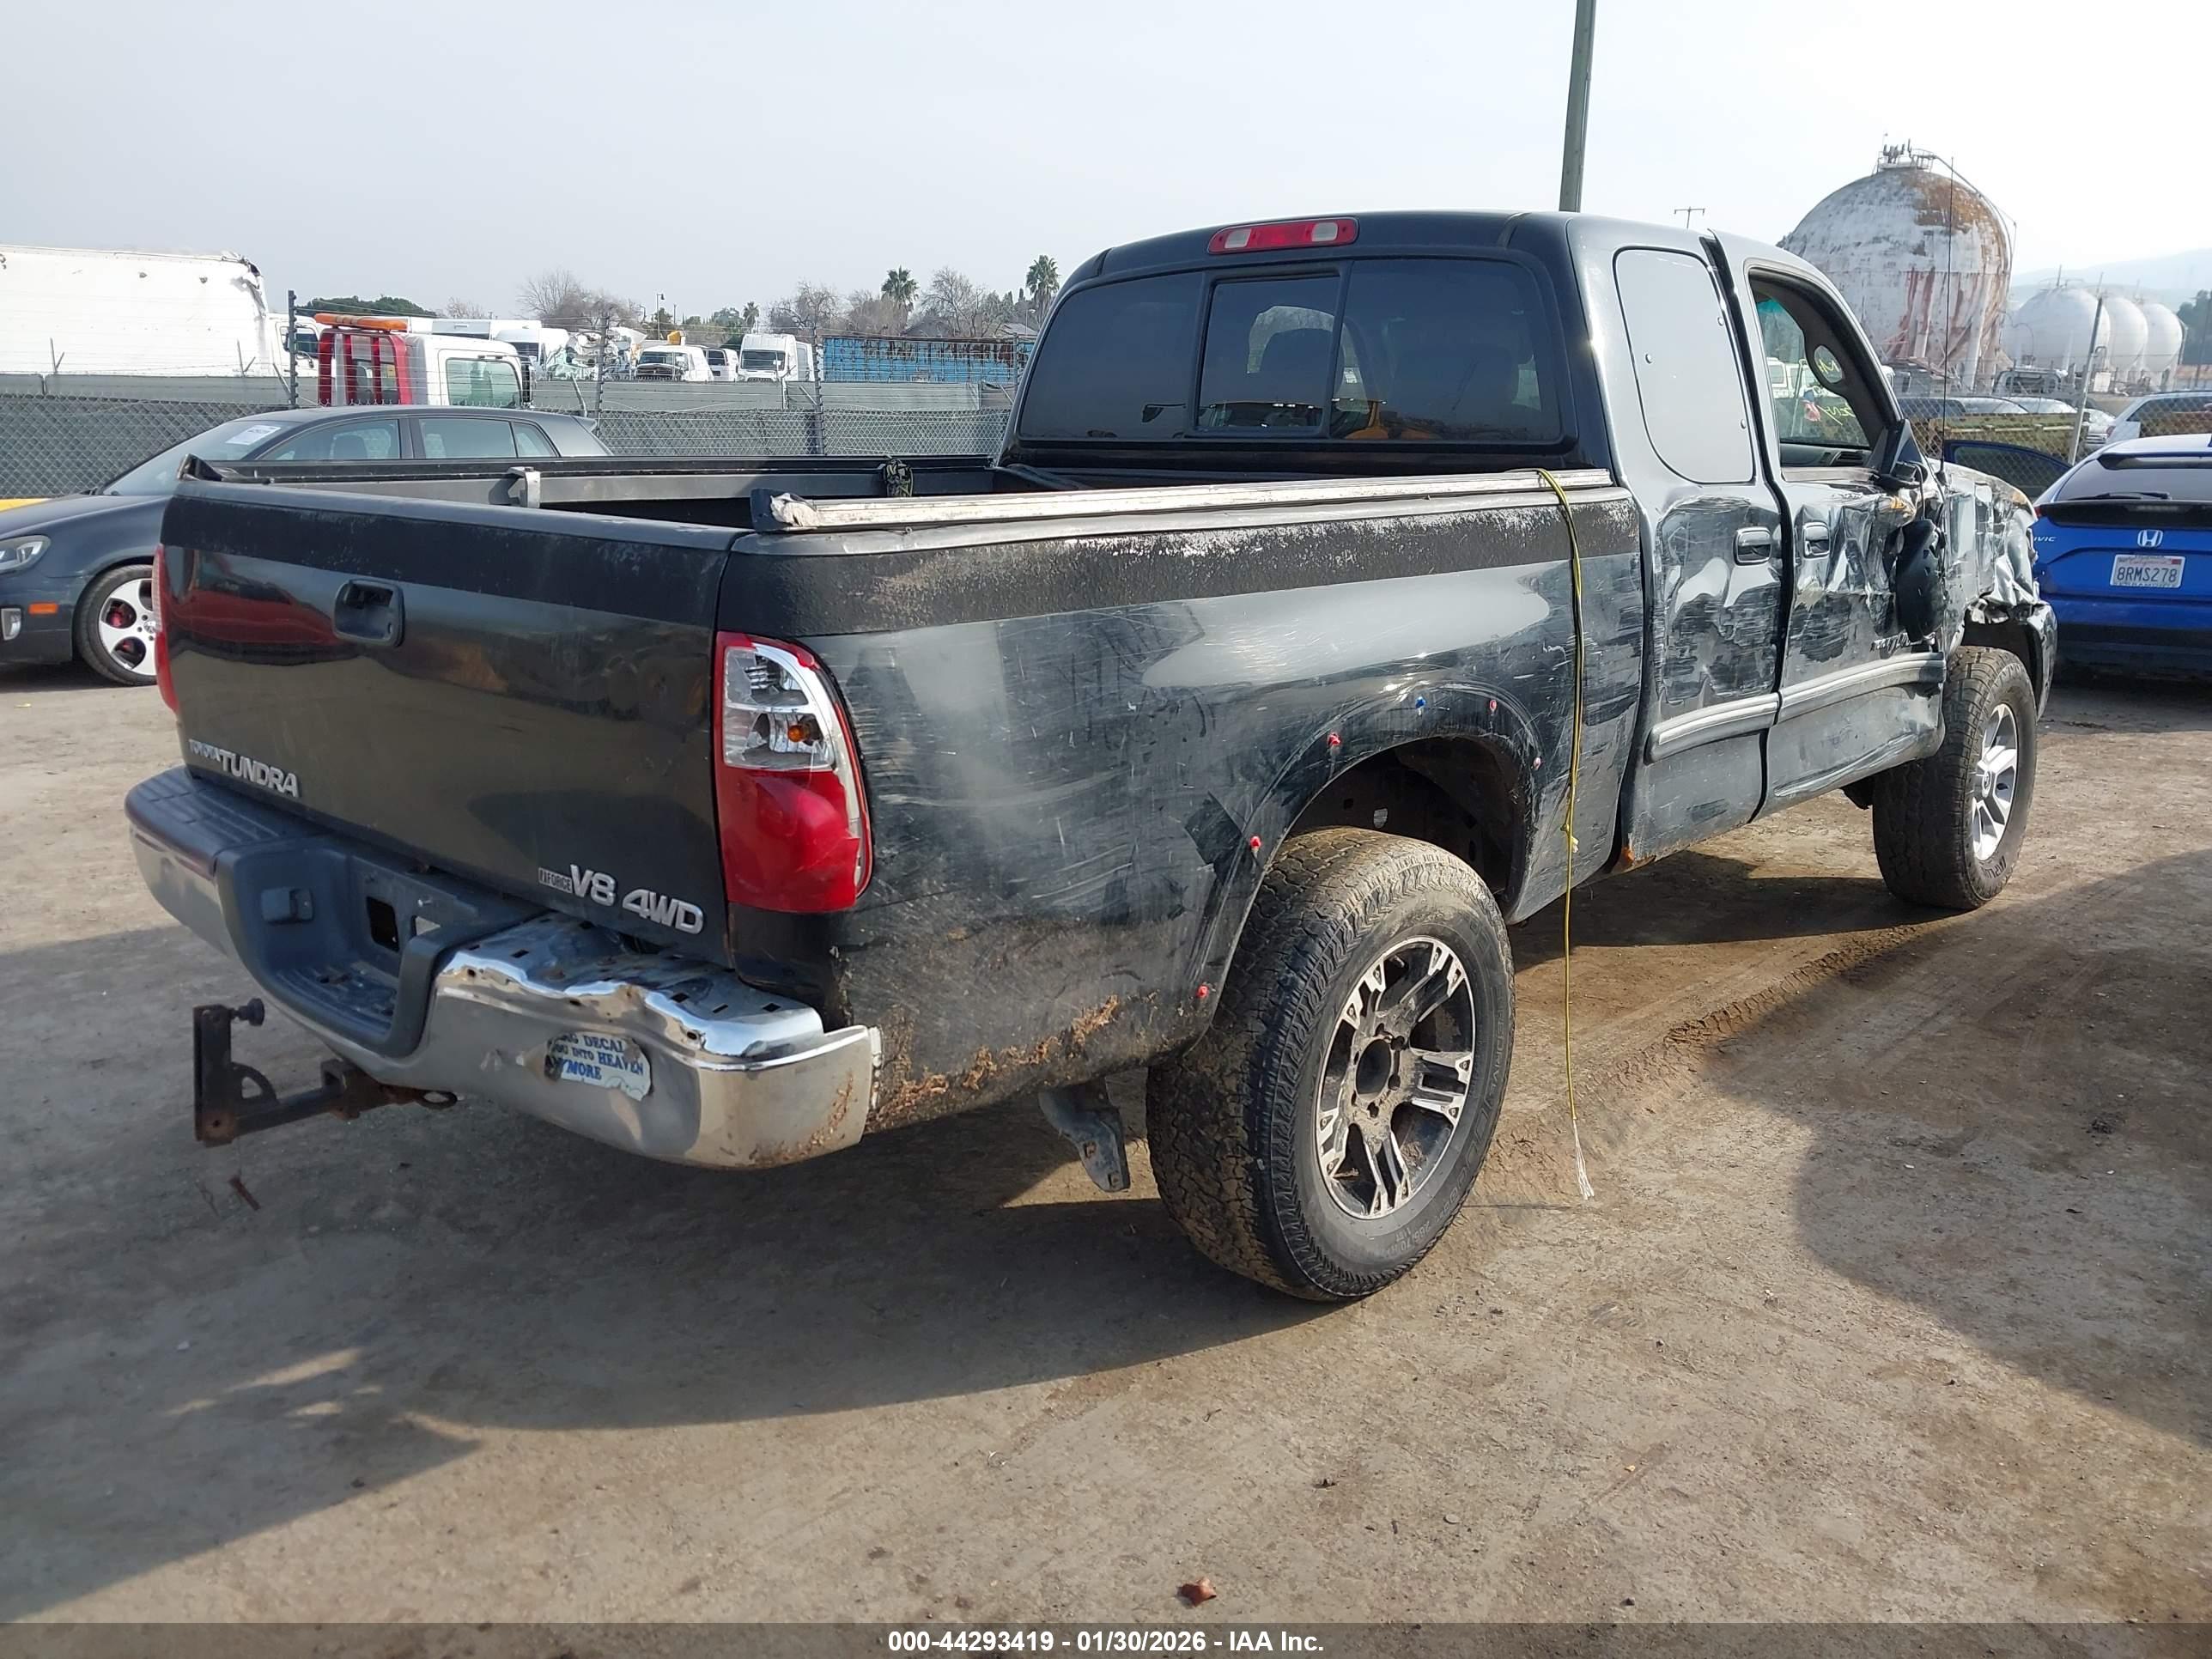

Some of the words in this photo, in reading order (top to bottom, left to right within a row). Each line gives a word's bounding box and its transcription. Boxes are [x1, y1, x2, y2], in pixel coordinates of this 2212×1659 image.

[2117, 567, 2178, 583] 8RMS278
[219, 749, 299, 798] TUNDRA
[570, 864, 617, 907] V8
[623, 889, 704, 935] 4WD
[571, 1047, 594, 1060] INTO
